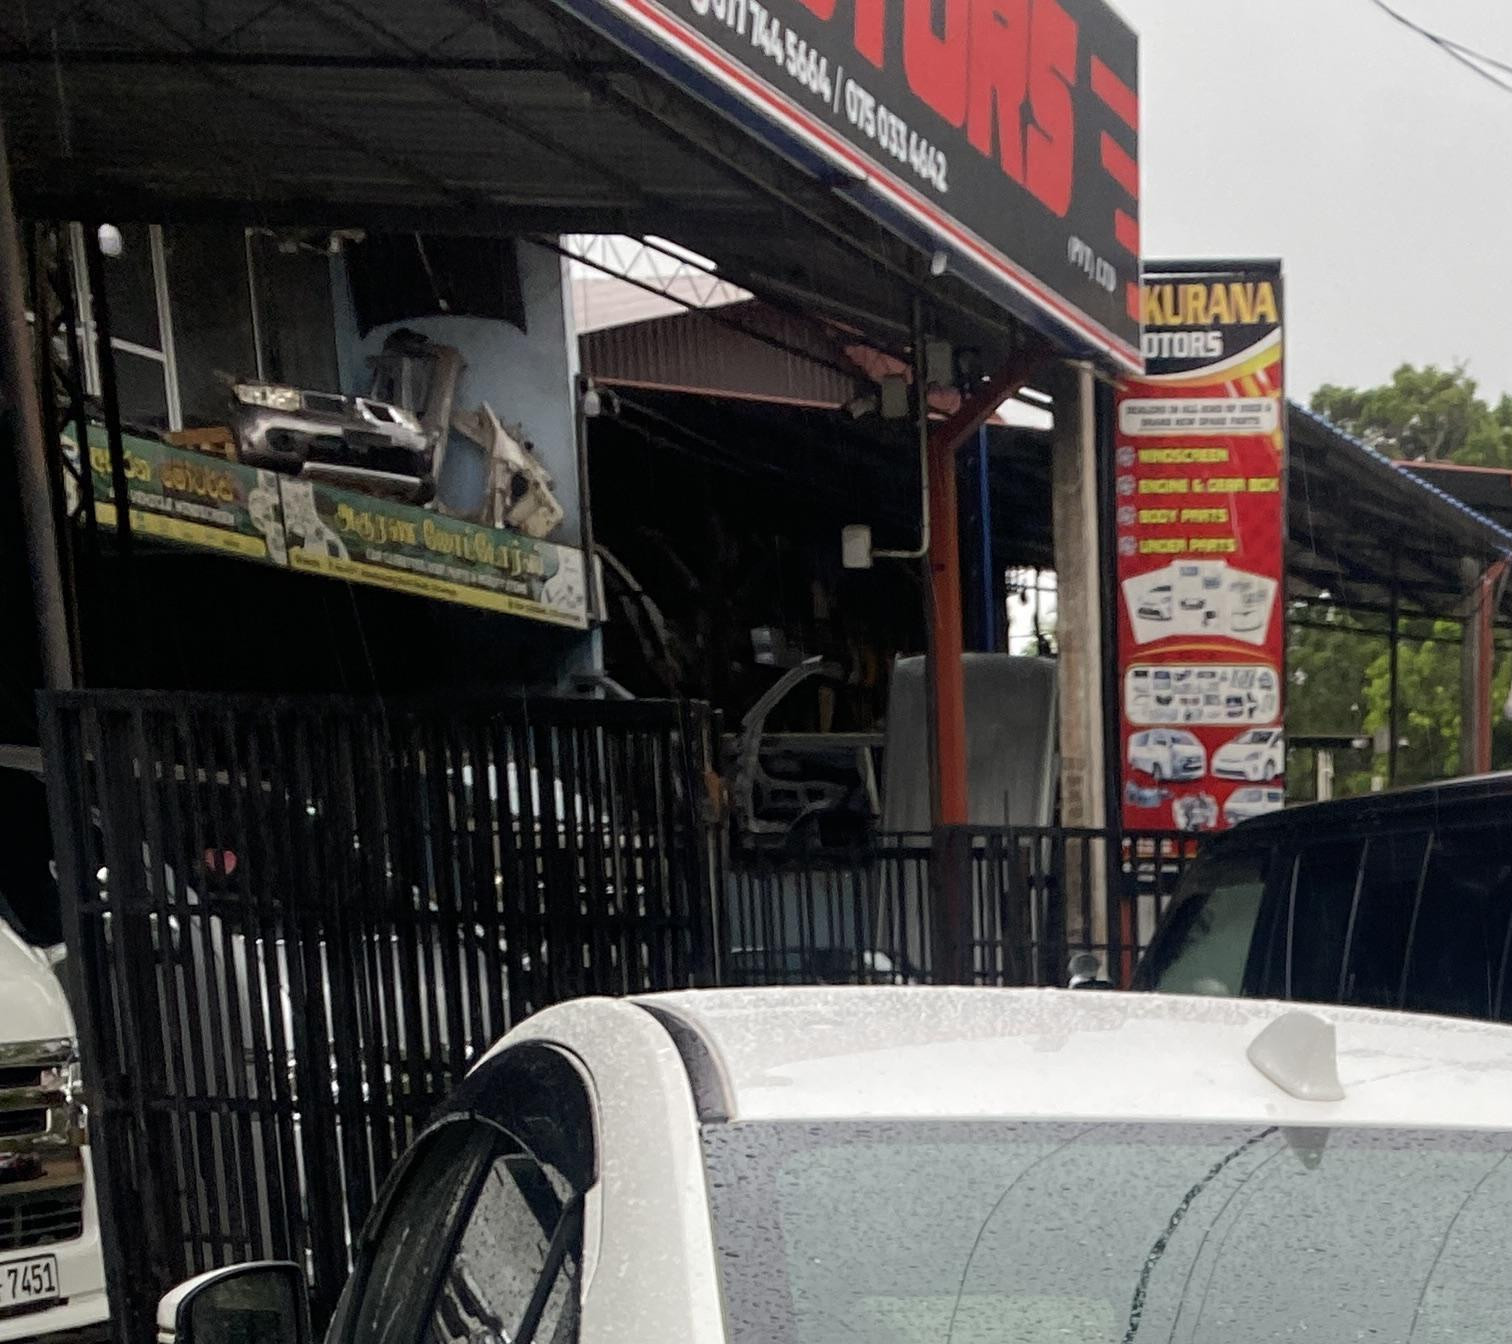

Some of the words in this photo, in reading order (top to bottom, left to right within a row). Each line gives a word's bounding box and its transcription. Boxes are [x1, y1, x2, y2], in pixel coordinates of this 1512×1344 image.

[845, 77, 876, 138] 075
[1138, 478, 1189, 494] ENGINE
[1138, 509, 1178, 525] BODY
[1180, 508, 1229, 524] PARTS
[1189, 537, 1237, 553] PARTS
[7, 1262, 56, 1299] 7451
